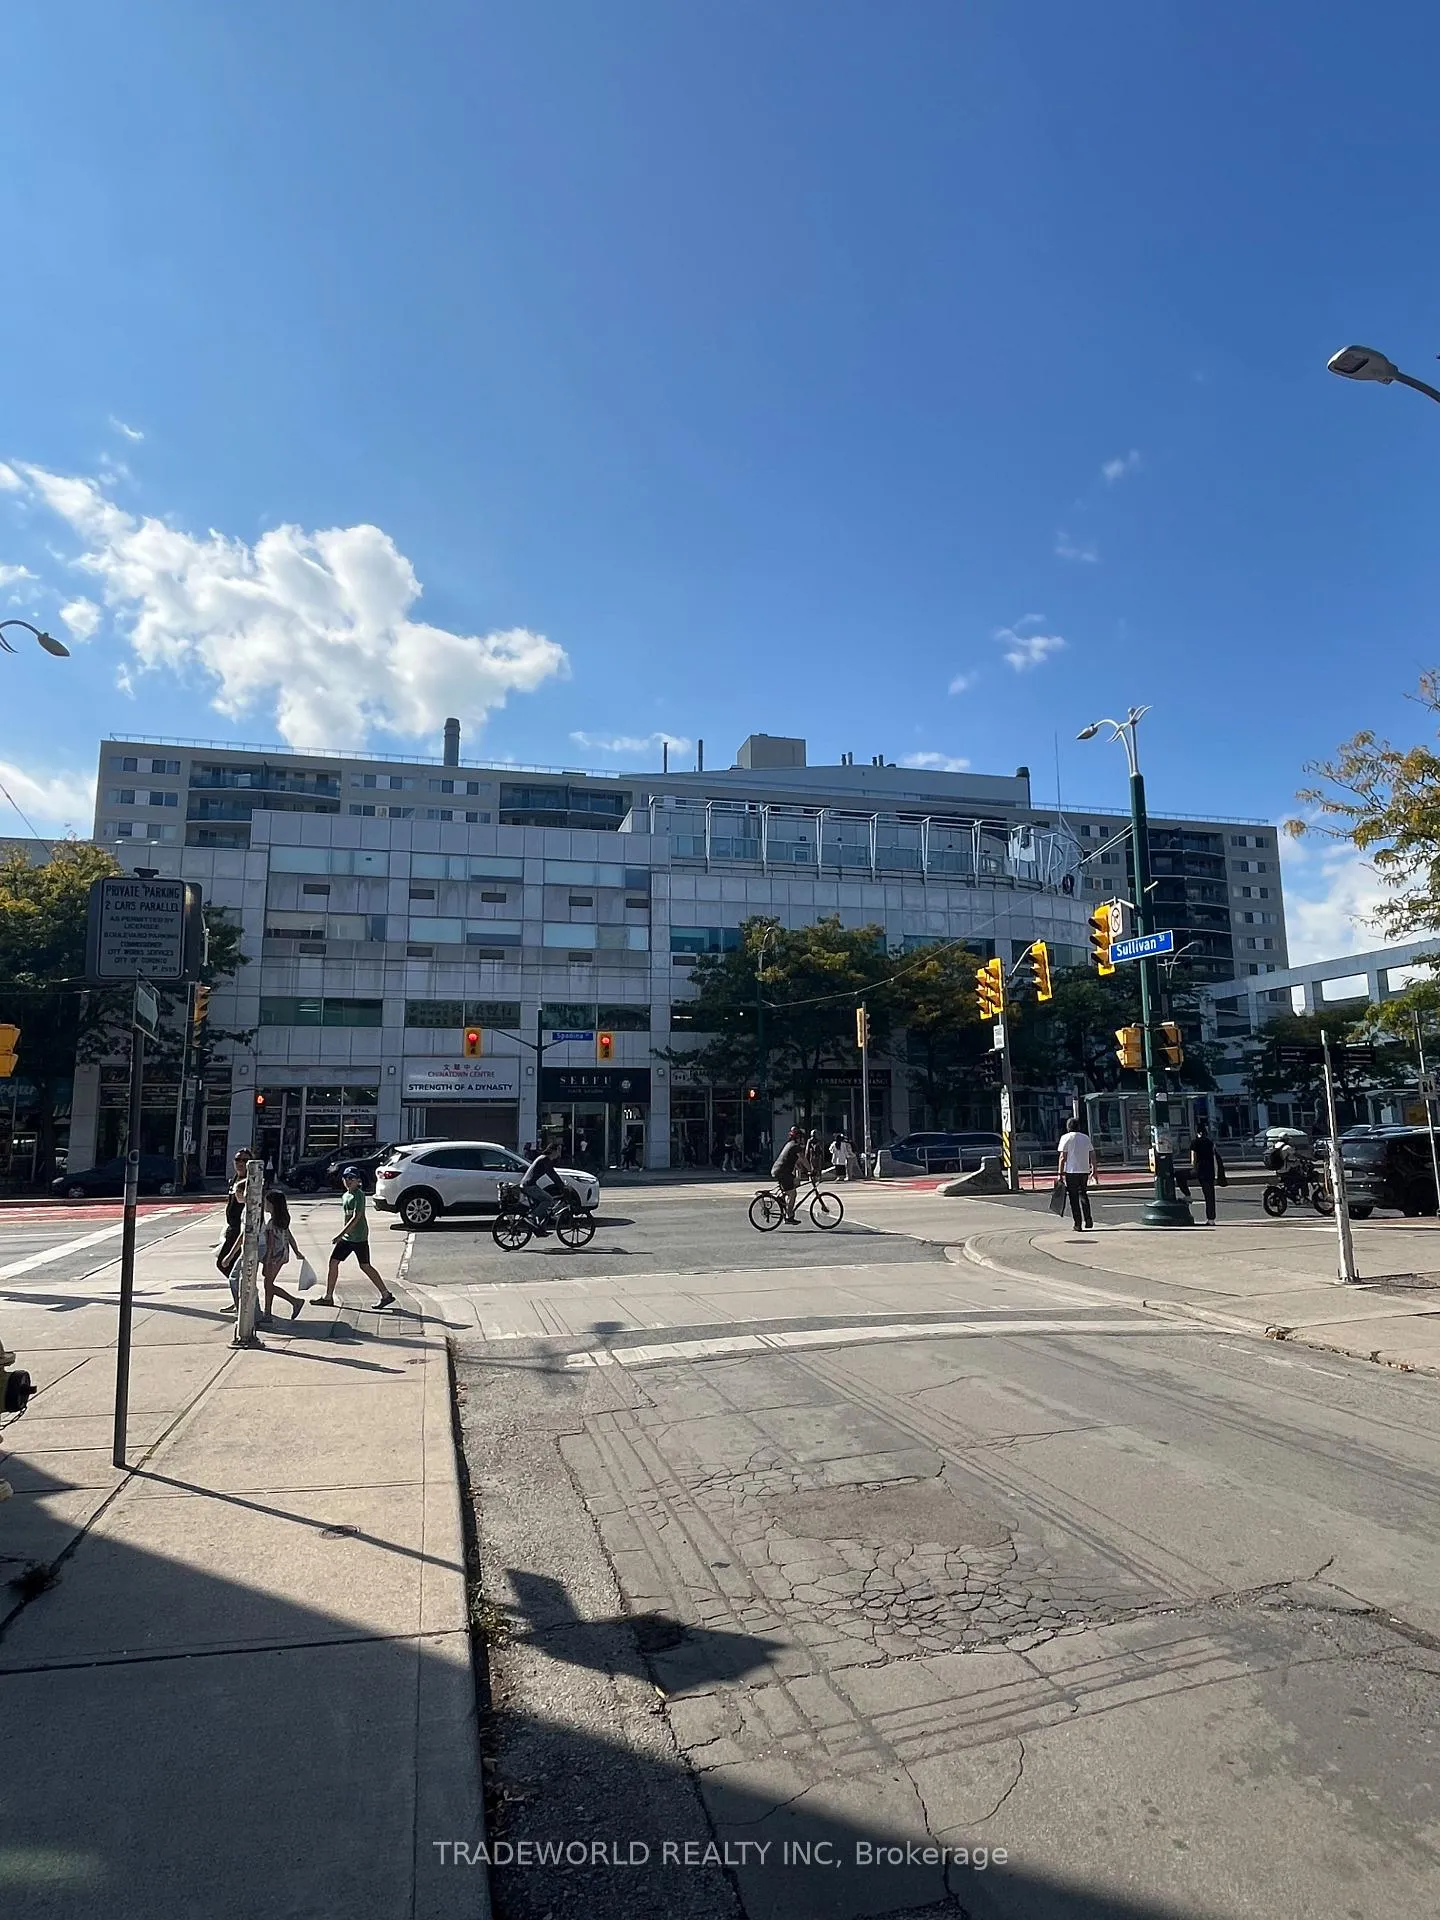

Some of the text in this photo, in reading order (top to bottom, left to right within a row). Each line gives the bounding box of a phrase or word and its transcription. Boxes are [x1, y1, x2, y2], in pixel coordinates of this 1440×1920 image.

[106, 885, 180, 899] PRIVATE PARKING
[105, 901, 180, 912] 2 CARS PARALLEL
[1116, 934, 1165, 957] Sullivan St
[427, 1070, 468, 1078] CHINATOWN
[408, 1083, 452, 1091] STRENGTH
